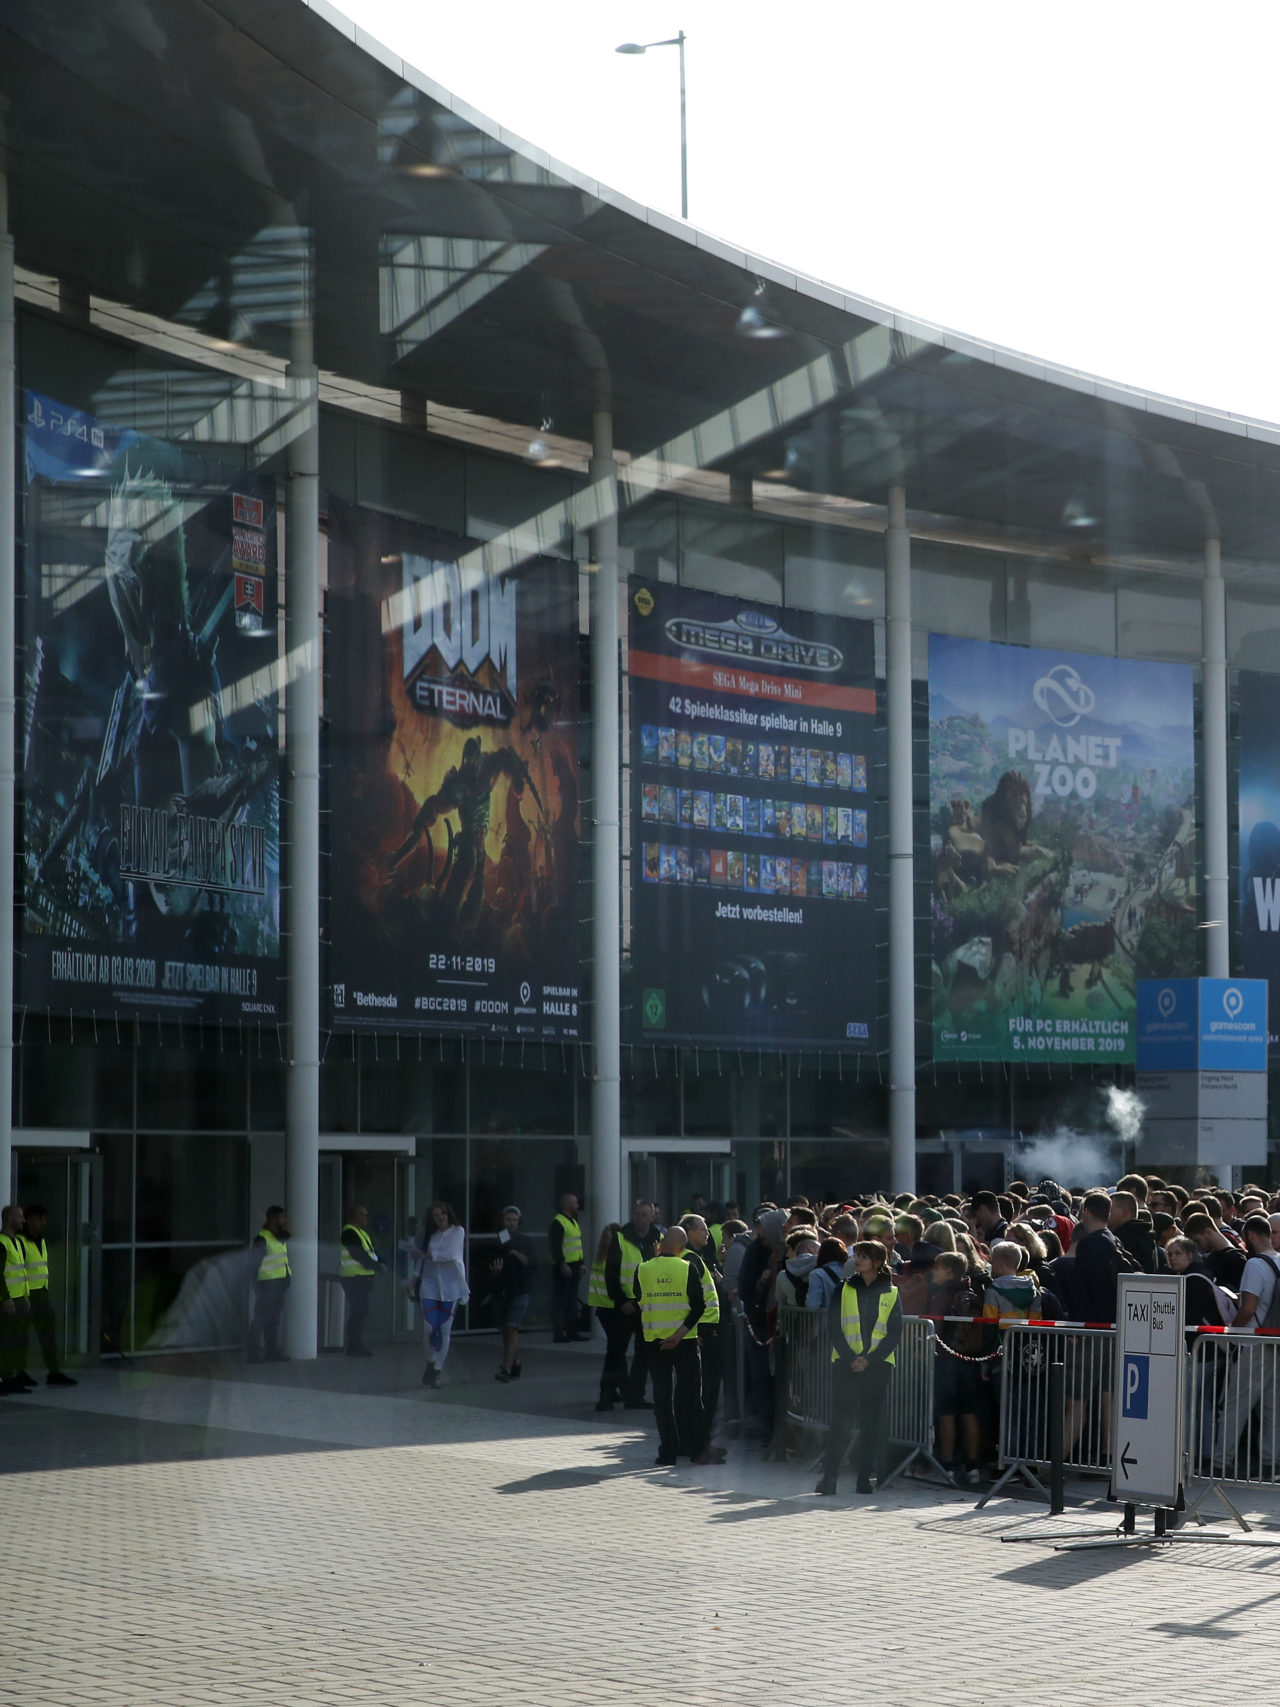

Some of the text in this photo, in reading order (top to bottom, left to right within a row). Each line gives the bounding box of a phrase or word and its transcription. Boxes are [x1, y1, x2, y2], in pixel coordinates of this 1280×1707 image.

[50, 410, 88, 443] PS4
[401, 552, 518, 705] DOOM
[681, 624, 830, 667] MEGA DRIVE
[713, 671, 802, 699] SEGA Mega Drive Mini
[416, 680, 507, 720] ETERNAL
[669, 696, 843, 738] 42 Spieleklassiker spielbar in Halle 9
[1007, 728, 1122, 768] PLANET
[1034, 763, 1097, 799] ZOO
[120, 804, 265, 888] FINAL FANTASY VII
[715, 902, 803, 924] Jetzt vorbestellen!
[51, 947, 258, 996] ERHÄLTLICH AB 03.03.2020 JETZT SPIELBAR IN HALLE 9
[356, 991, 398, 1008] Bethesda
[571, 987, 578, 997] IN
[414, 996, 509, 1014] #BGC2019 #DOOM
[543, 1001, 578, 1017] HALLE 8
[1009, 1016, 1129, 1035] FÜR PC ERHÄLTLICH
[1210, 1021, 1256, 1032] gamescom
[1013, 1036, 1025, 1050] 5.
[1028, 1036, 1095, 1051] NOVEMBER
[1098, 1037, 1126, 1052] 2019
[1127, 1303, 1149, 1322] TAXI
[1153, 1301, 1176, 1315] Shuttle
[1152, 1317, 1164, 1330] Bus
[1126, 1362, 1139, 1410] P
